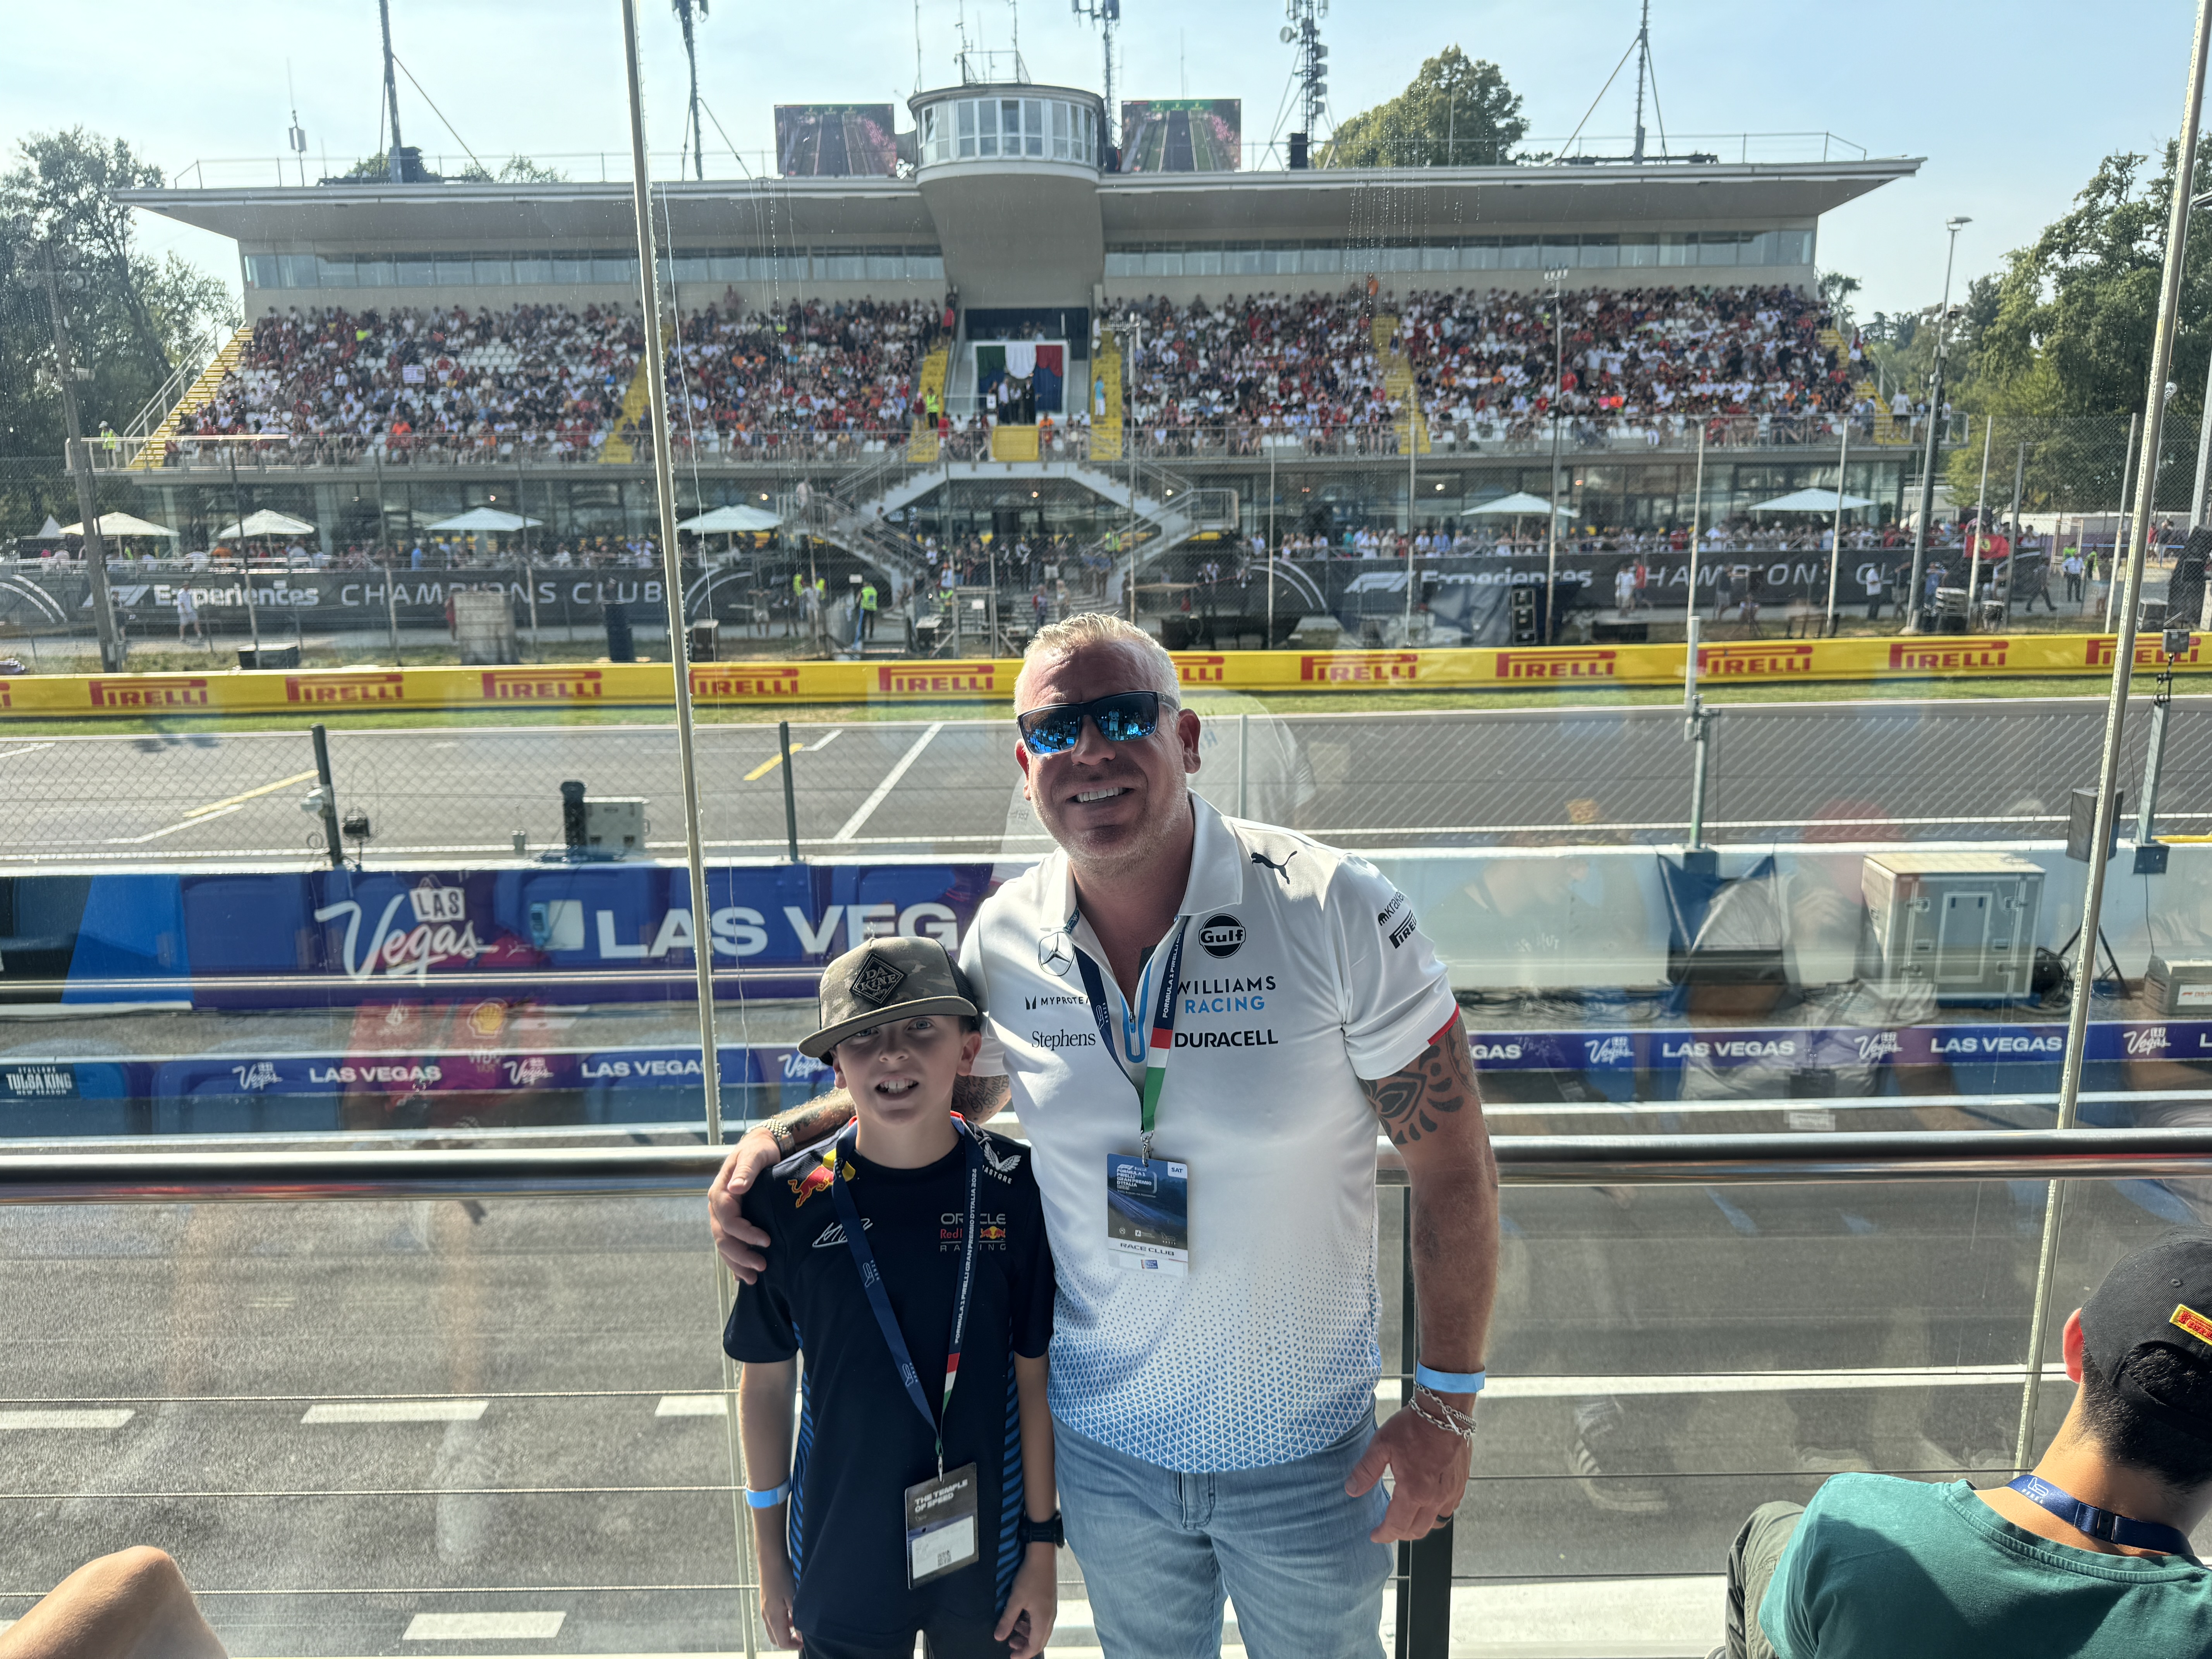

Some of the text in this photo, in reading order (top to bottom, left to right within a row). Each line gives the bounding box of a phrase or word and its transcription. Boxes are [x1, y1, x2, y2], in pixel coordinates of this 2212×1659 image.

[154, 582, 319, 609] Eperiences
[1698, 646, 1813, 674] PIRELLI
[1889, 641, 2009, 669] PIRELLI
[2086, 637, 2201, 665] PIELLI
[1301, 654, 1418, 681] PIRELLI
[1496, 651, 1616, 678] PIRELLI
[285, 675, 404, 702] PIRELLI
[482, 670, 603, 698] PIRELLI
[878, 665, 995, 692] PIRELLI
[89, 678, 208, 706] PIRELLI
[417, 891, 459, 917] LAS
[314, 894, 500, 988] Vegas
[596, 902, 958, 959] LAS VEG
[1200, 929, 1243, 943] Gulf
[866, 967, 888, 982] DA
[1177, 975, 1276, 995] WILLIAMS
[1163, 979, 1174, 1018] FORMULA
[1185, 996, 1265, 1013] RACING
[1032, 1029, 1096, 1051] Stephens
[1175, 1029, 1278, 1047] DURACELL
[1662, 1041, 1796, 1058] LAS VEGAS
[1930, 1036, 2063, 1053] LAS VEGAS
[2123, 1029, 2172, 1056] Vegas
[1470, 1044, 1522, 1060] GAS
[44, 1072, 73, 1090] KING
[309, 1065, 443, 1083] LAS VEGAS
[582, 1060, 703, 1078] LAS VEGA
[982, 1164, 1012, 1185] ASTORE
[940, 1243, 1006, 1252] RAING
[1120, 1242, 1175, 1256] RACE CLUB
[955, 1305, 965, 1345] FORMULA
[961, 1272, 970, 1300] PIRELLI
[914, 1479, 968, 1505] THE TEMPLE
[915, 1492, 954, 1513] OF SPEED
